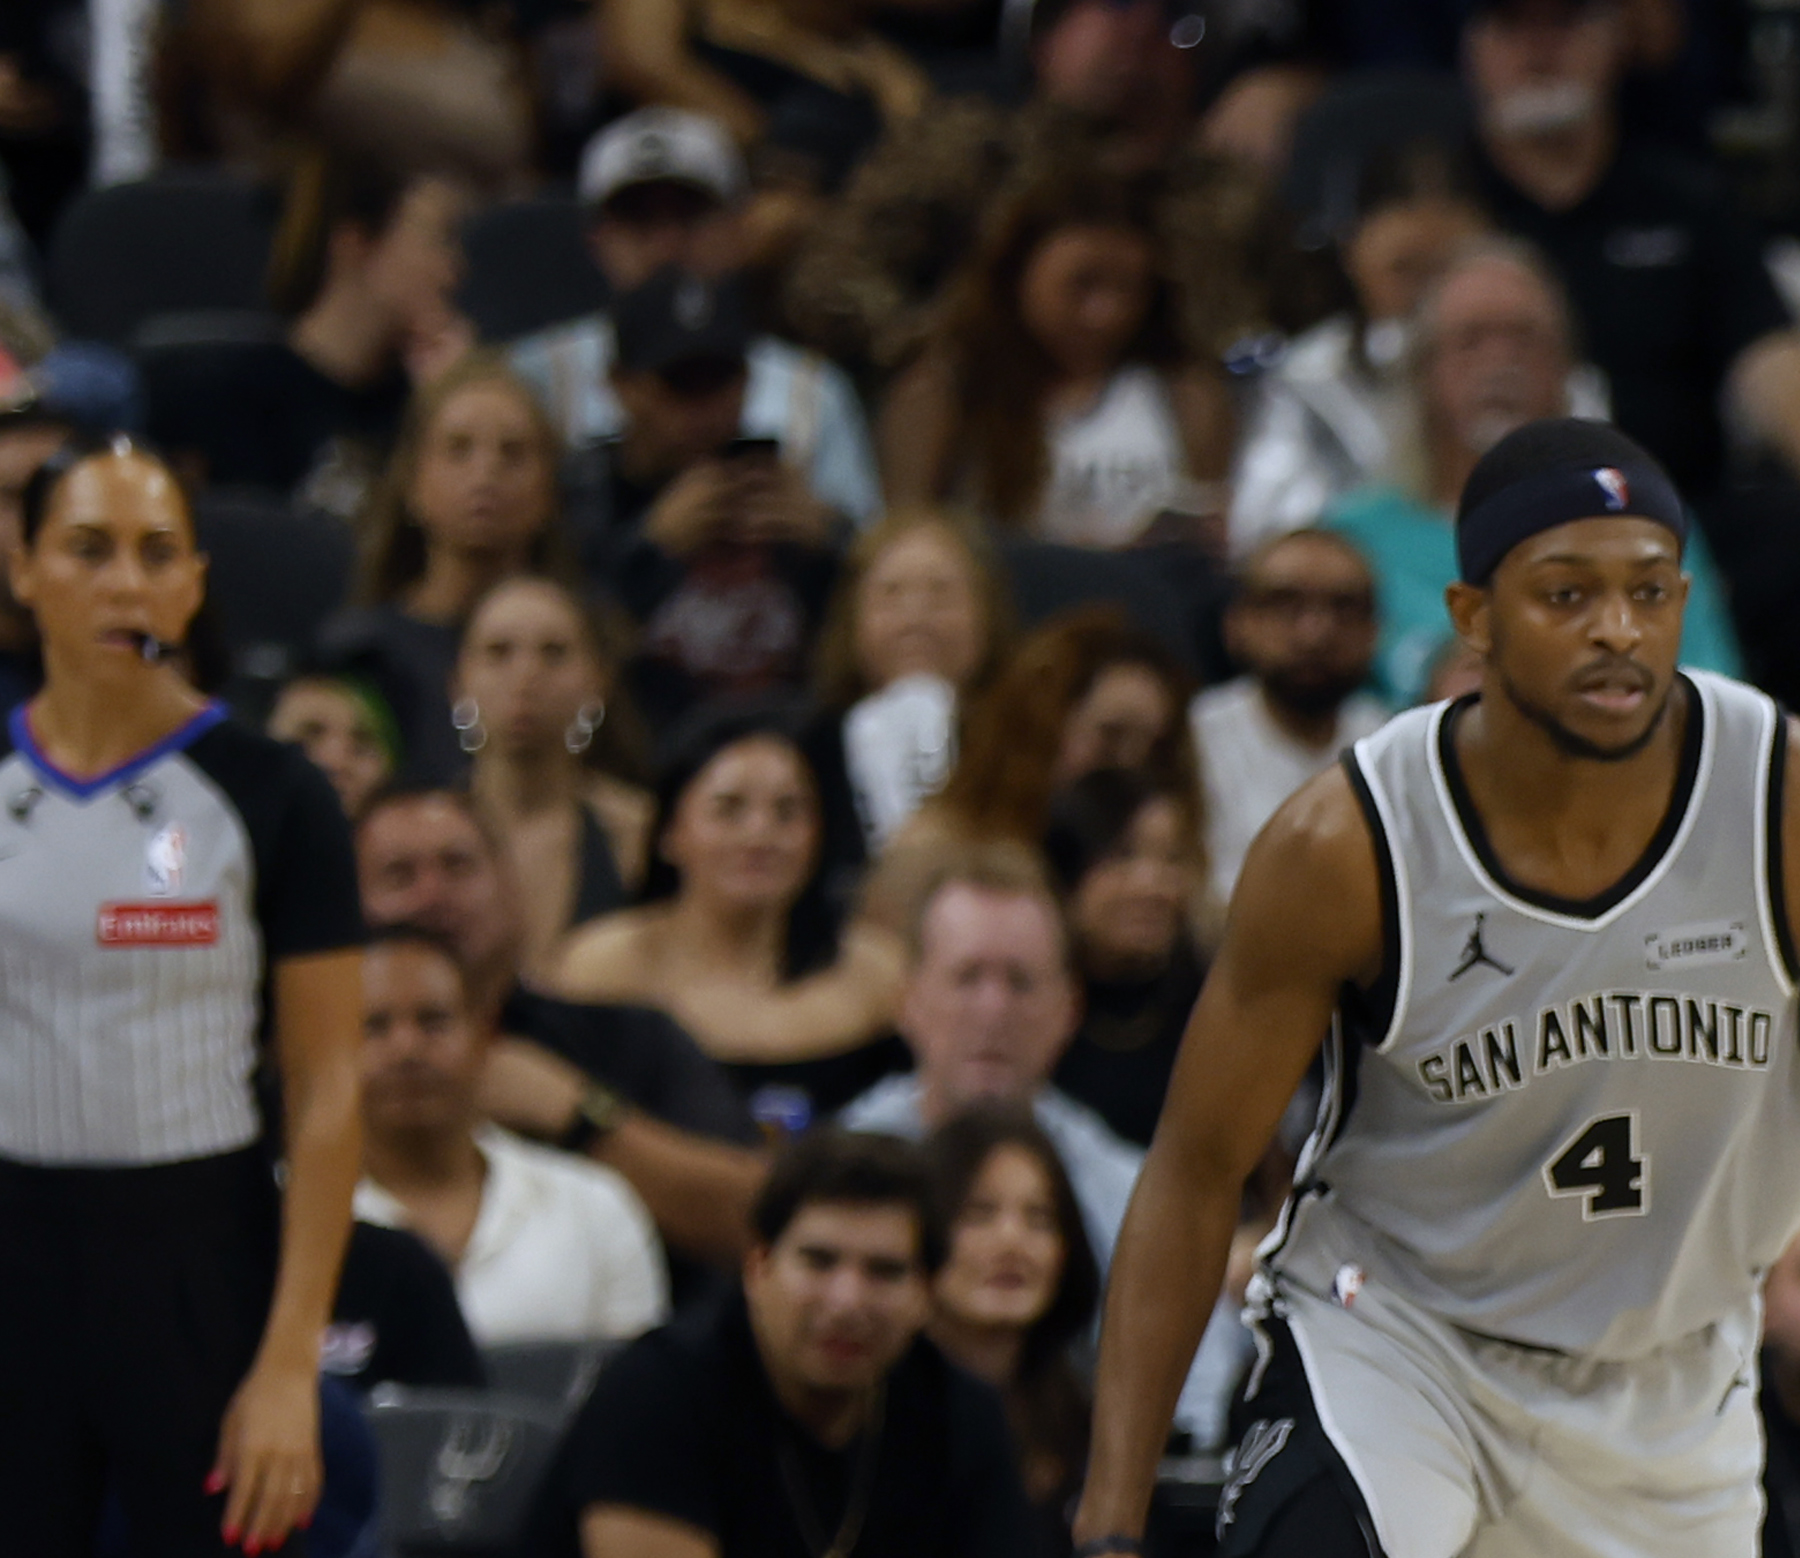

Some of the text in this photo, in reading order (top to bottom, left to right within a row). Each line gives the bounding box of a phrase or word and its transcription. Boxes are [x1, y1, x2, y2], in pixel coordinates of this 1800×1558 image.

[1416, 988, 1774, 1104] SAN ANTONIO
[1541, 1109, 1650, 1222] 4
